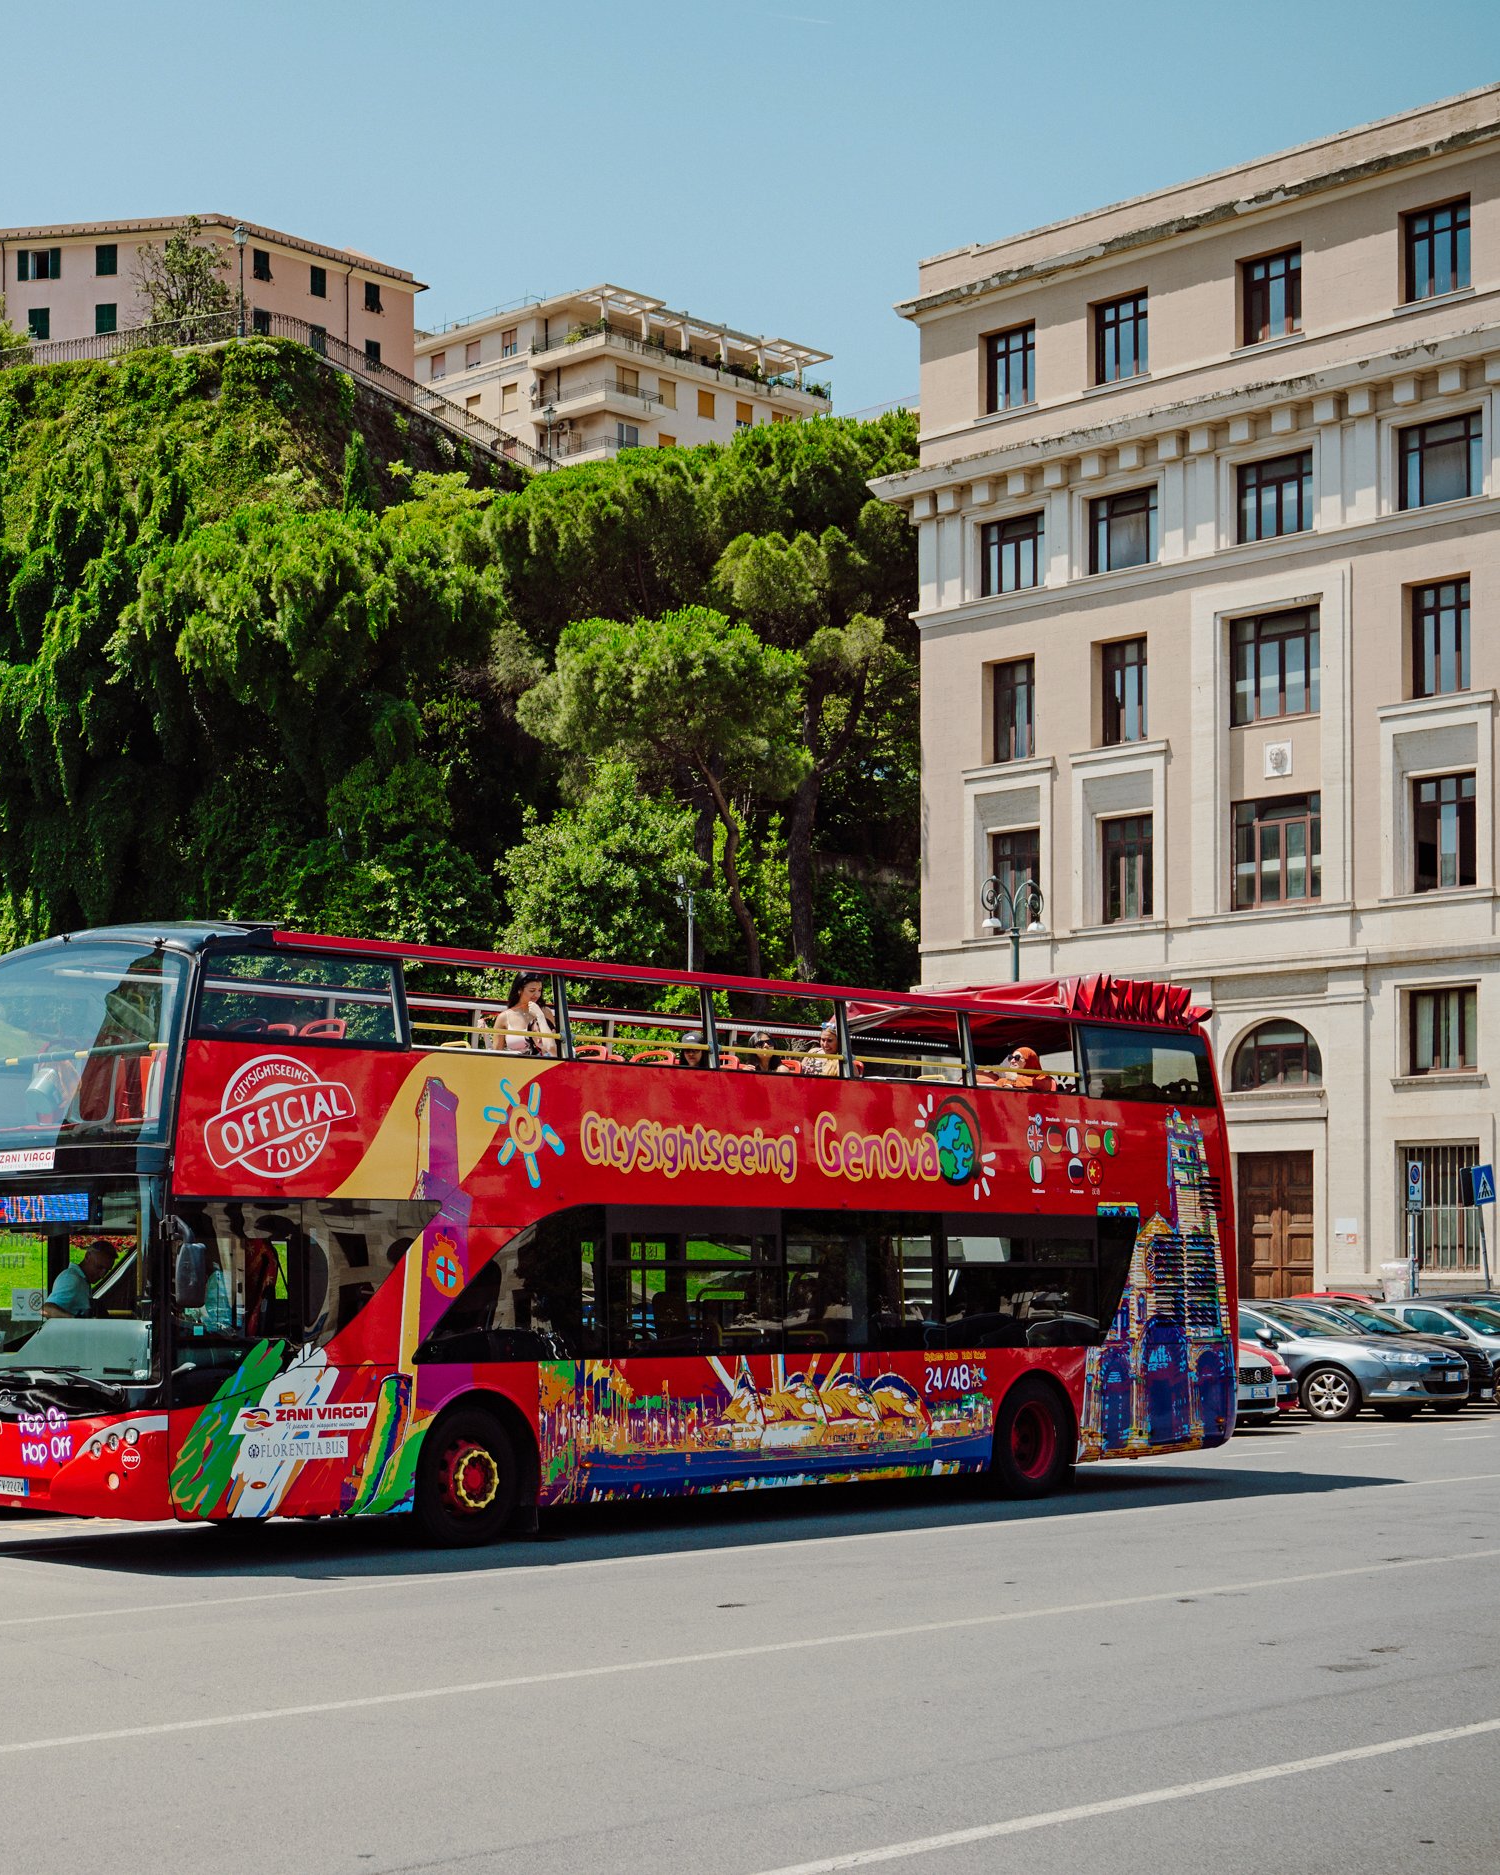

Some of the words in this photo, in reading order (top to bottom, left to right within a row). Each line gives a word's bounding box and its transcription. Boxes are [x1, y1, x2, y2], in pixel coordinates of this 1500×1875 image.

[233, 1063, 309, 1103] CITYSIGHTSEEING
[220, 1088, 347, 1154] OFFICIAL
[0, 1154, 20, 1164] ZANI
[23, 1151, 55, 1162] VIAGGI
[265, 1132, 321, 1169] TOUR
[815, 1111, 941, 1182] Genova
[925, 1364, 970, 1393] 24/48
[17, 1414, 45, 1434] Hop
[47, 1408, 68, 1430] On
[276, 1408, 312, 1422] ZANI
[316, 1405, 368, 1420] VIAGGI
[21, 1442, 47, 1463] Hop
[50, 1436, 72, 1459] Off
[124, 1455, 140, 1463] 2037
[261, 1442, 322, 1457] FLORENTIA
[326, 1441, 344, 1454] BUS
